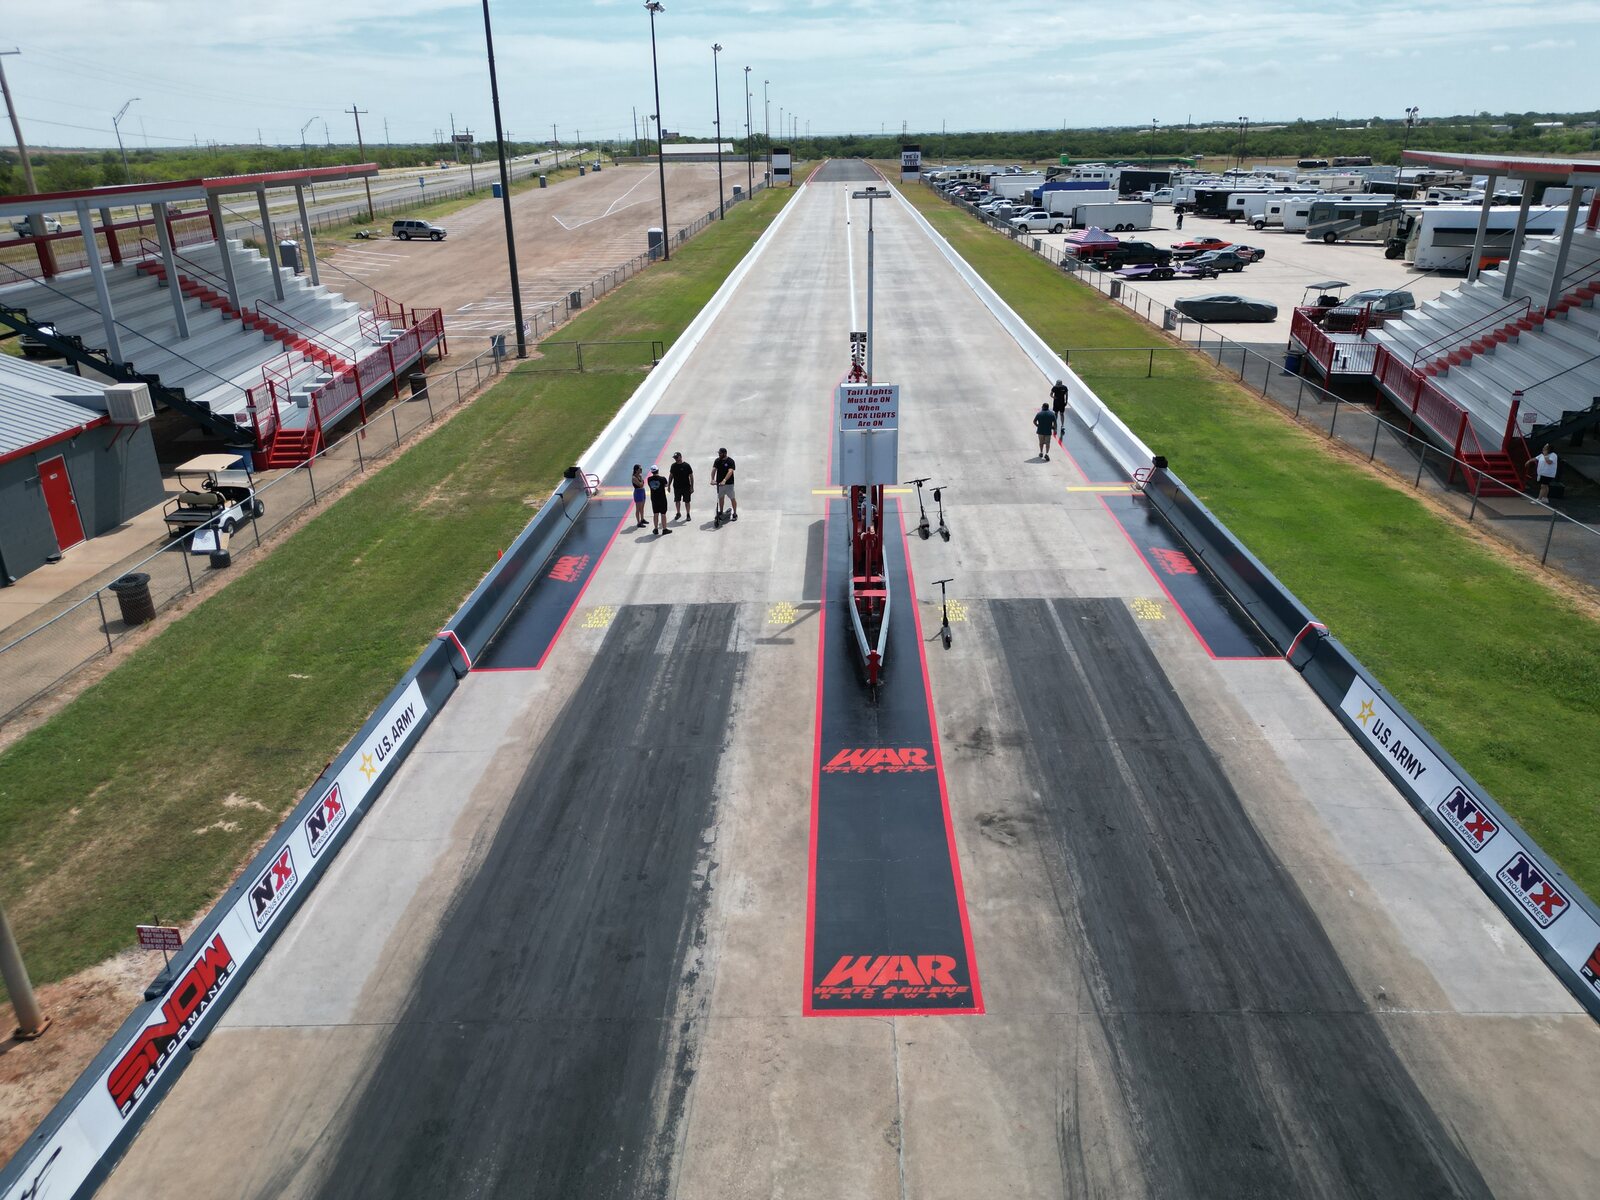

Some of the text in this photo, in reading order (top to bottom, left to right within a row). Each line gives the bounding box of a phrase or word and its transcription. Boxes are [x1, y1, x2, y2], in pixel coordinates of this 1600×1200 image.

[374, 702, 417, 762] U.S. ARMY
[826, 748, 929, 766] WAR
[1372, 718, 1427, 781] U.S. ARMY
[308, 787, 342, 845] NX
[1440, 805, 1481, 849] NITROUS EXPRESS
[1446, 790, 1496, 843] NX
[252, 850, 293, 918] NX
[257, 873, 296, 927] NITROUS EXPRESS
[1500, 871, 1549, 925] NITROUS EXPRESS
[1506, 856, 1566, 919] NX
[819, 955, 958, 986] WAR
[107, 933, 233, 1109] SNOW
[121, 961, 236, 1117] PERFORMANCE
